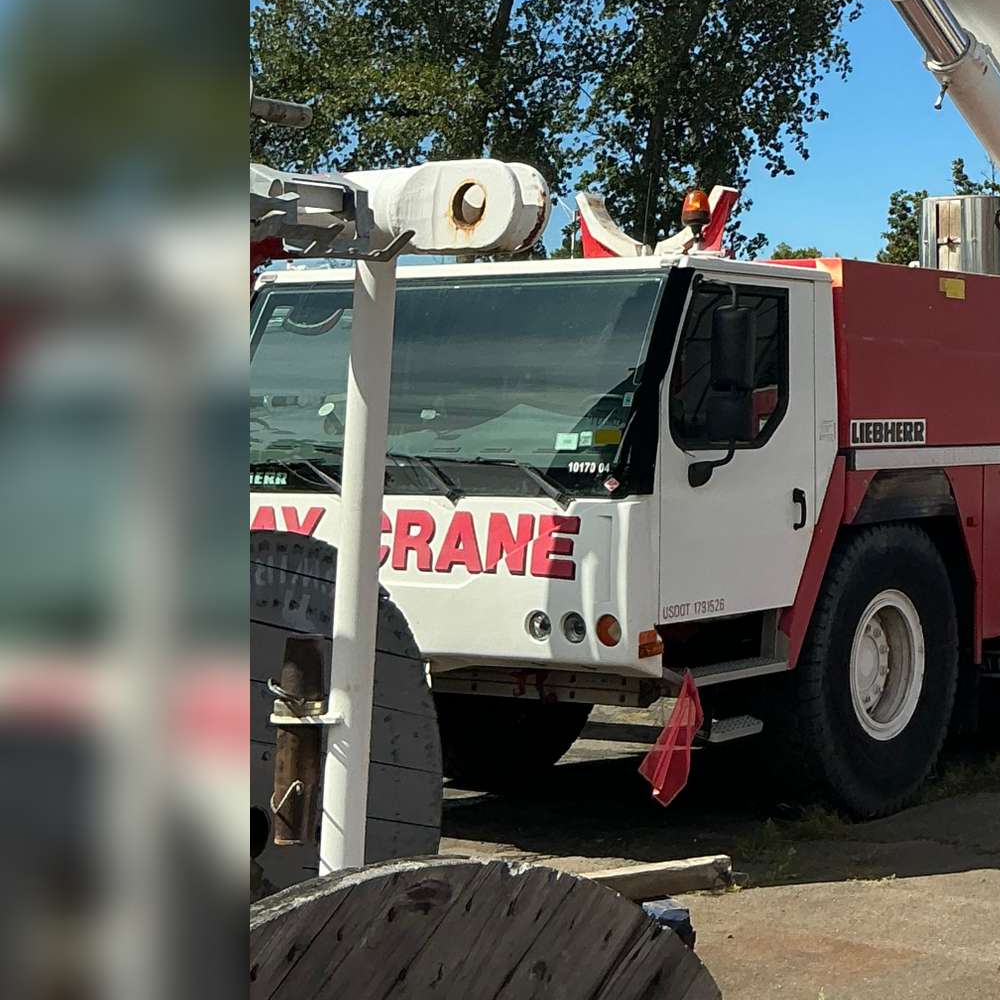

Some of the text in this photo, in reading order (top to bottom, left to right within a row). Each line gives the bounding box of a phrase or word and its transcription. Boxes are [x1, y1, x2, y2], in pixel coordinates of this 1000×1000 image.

[852, 421, 925, 444] LIEBHERR
[568, 461, 597, 474] 10170
[662, 602, 691, 620] USDOT
